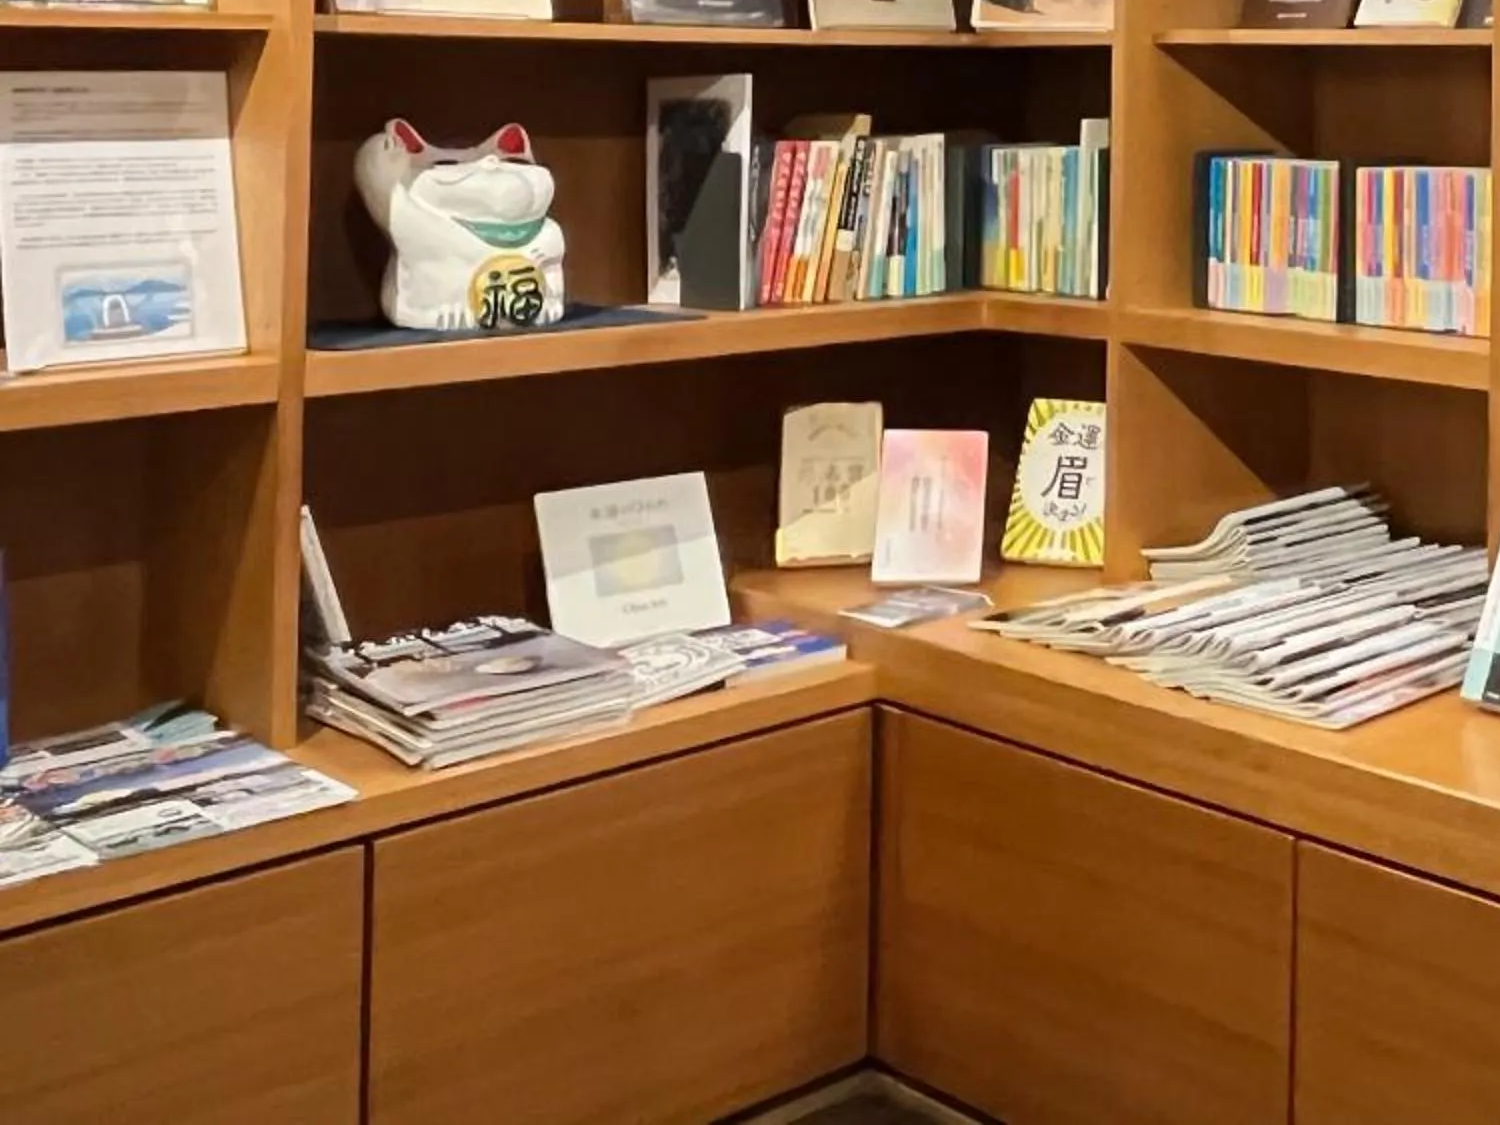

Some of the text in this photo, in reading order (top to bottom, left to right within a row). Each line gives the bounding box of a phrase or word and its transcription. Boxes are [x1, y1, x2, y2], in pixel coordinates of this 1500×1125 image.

[478, 265, 544, 329] 福
[1048, 421, 1101, 450] 金運
[1040, 455, 1087, 500] 眉
